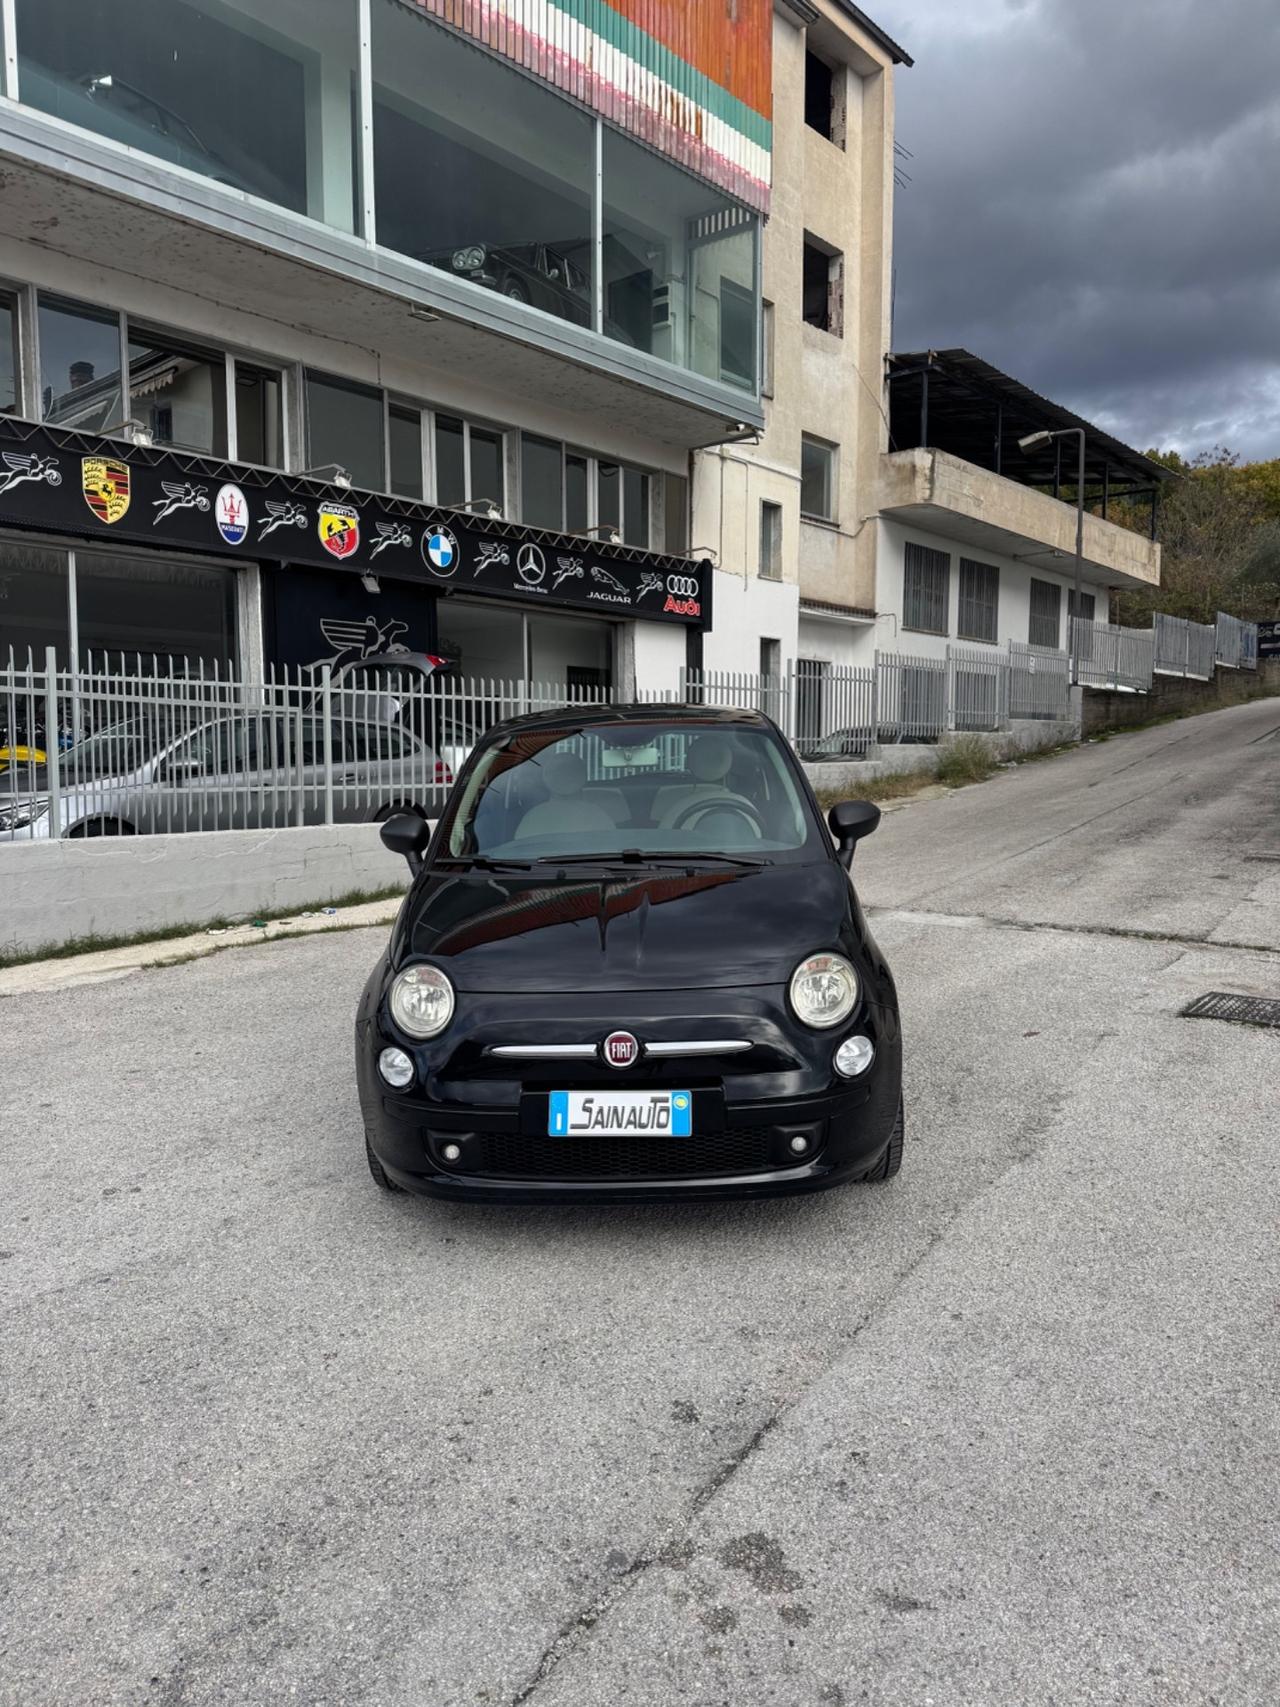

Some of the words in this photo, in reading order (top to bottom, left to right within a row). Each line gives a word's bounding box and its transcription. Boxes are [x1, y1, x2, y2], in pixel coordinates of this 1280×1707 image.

[84, 458, 129, 471] PORSCHE
[322, 505, 356, 518] ABARTH
[425, 525, 457, 545] BMW
[586, 591, 632, 605] JAGUAR
[663, 594, 701, 617] Audi
[611, 1042, 632, 1059] FIAT
